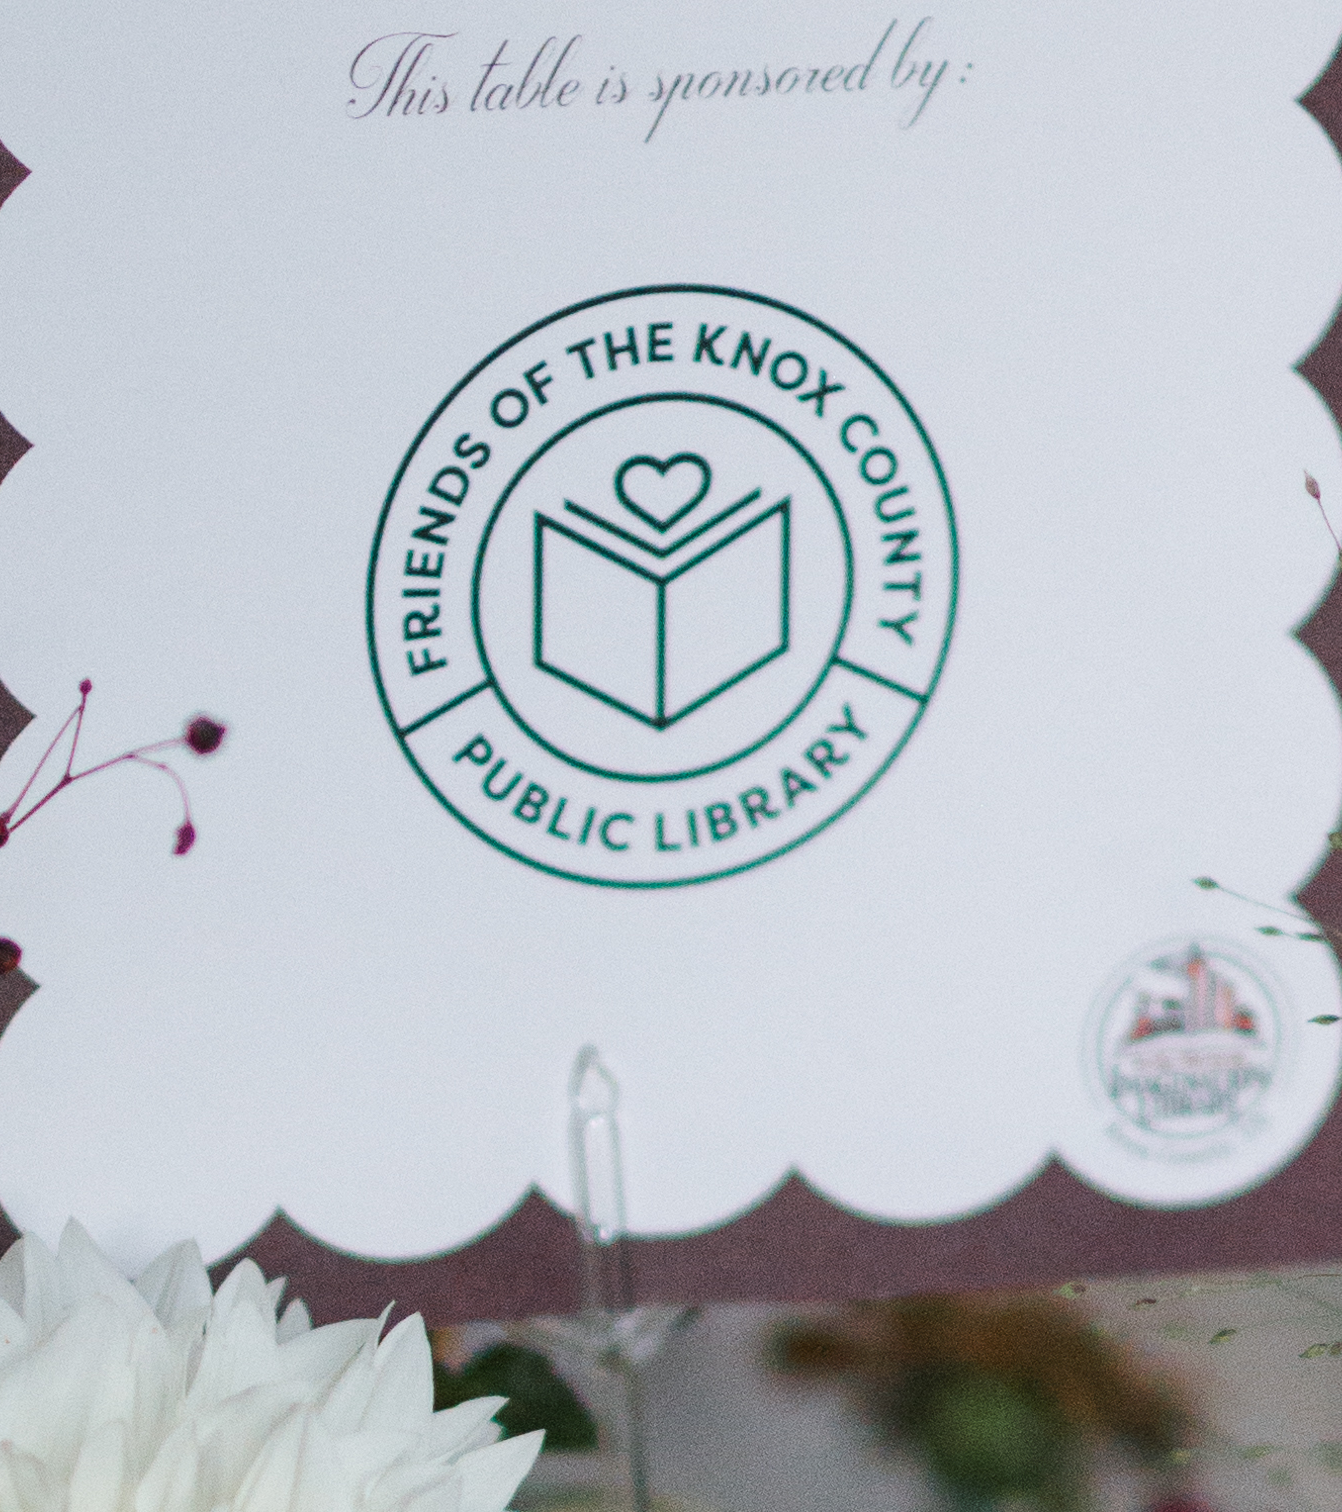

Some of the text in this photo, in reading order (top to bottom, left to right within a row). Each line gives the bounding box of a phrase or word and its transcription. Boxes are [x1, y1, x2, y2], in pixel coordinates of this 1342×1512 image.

[346, 16, 975, 145] This table is sponsored by:
[399, 319, 925, 679] FRIENDS OF THE KNOX COUNTY
[449, 700, 870, 855] PUBLIC LIBRARY
